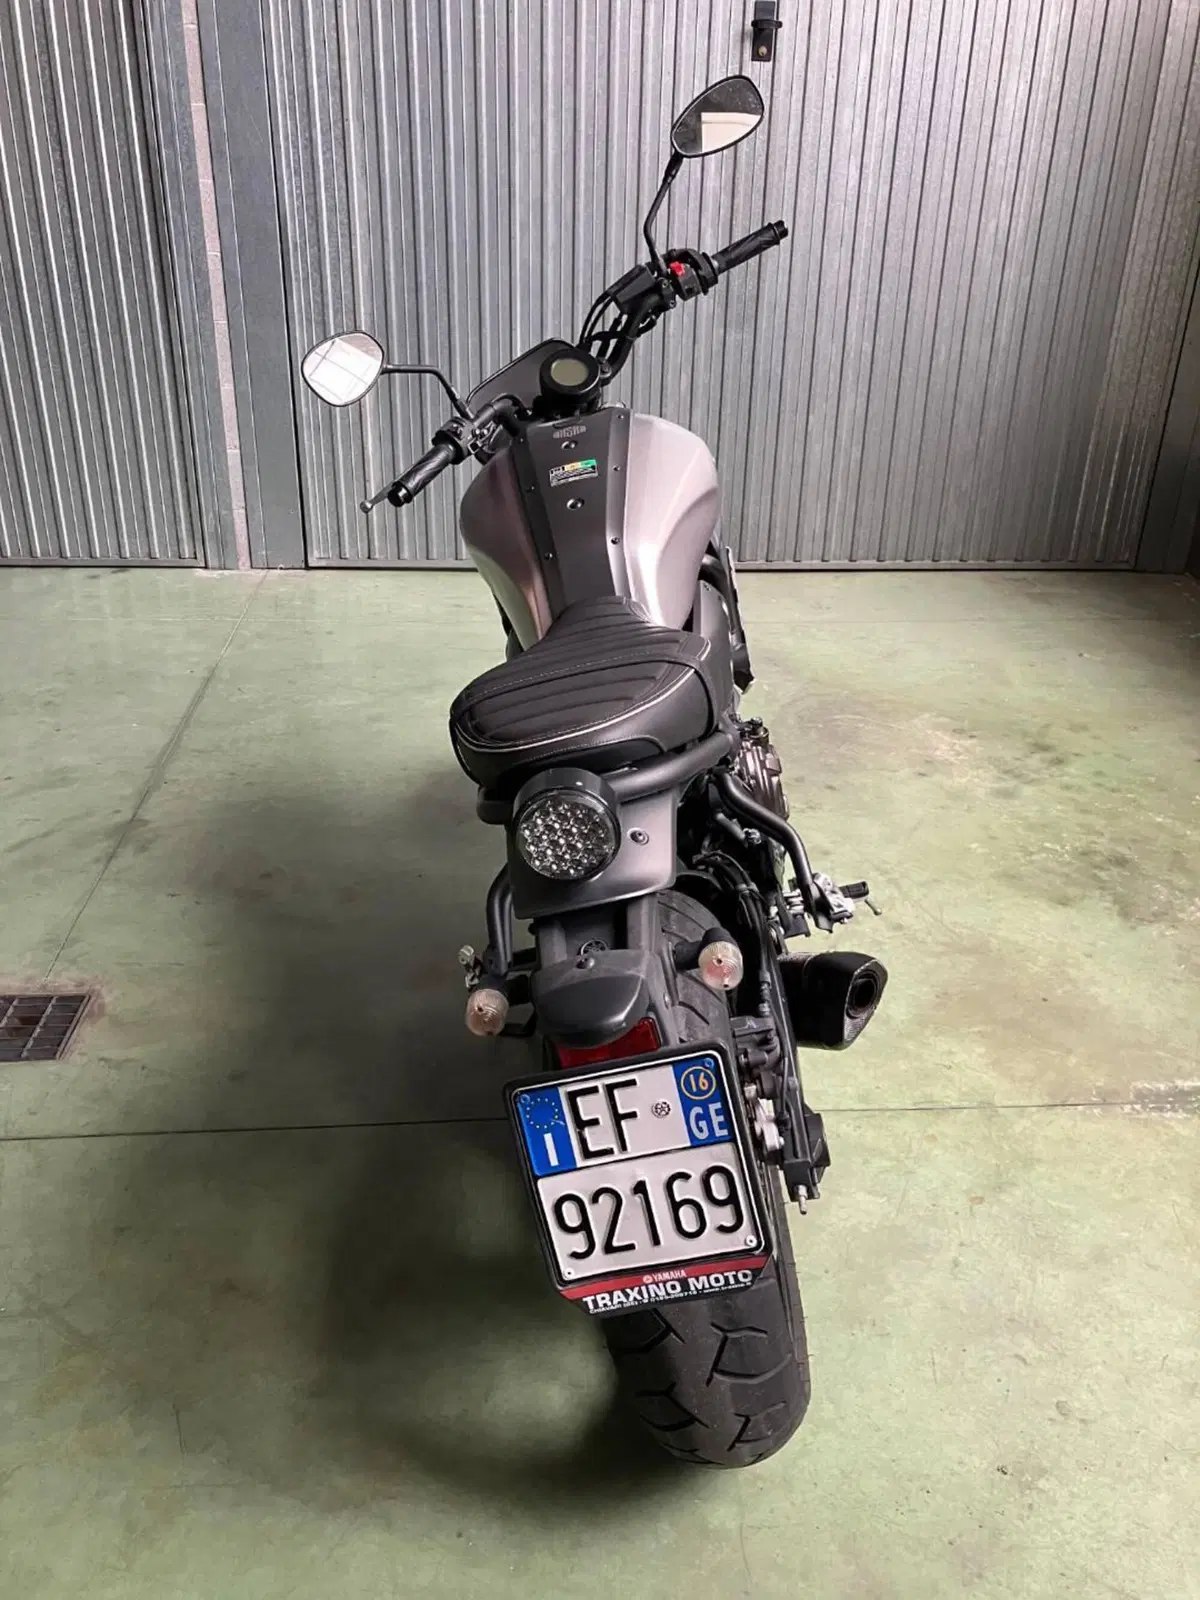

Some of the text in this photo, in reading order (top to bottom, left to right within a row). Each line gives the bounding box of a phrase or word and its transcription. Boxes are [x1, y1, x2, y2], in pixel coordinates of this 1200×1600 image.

[688, 1073, 709, 1092] 16
[565, 1078, 639, 1160] EF
[689, 1102, 729, 1141] GE
[543, 1132, 560, 1167] I
[553, 1164, 745, 1260] 92169
[582, 1269, 753, 1310] TRAXINO MOTO
[652, 1268, 688, 1282] YAMAHA
